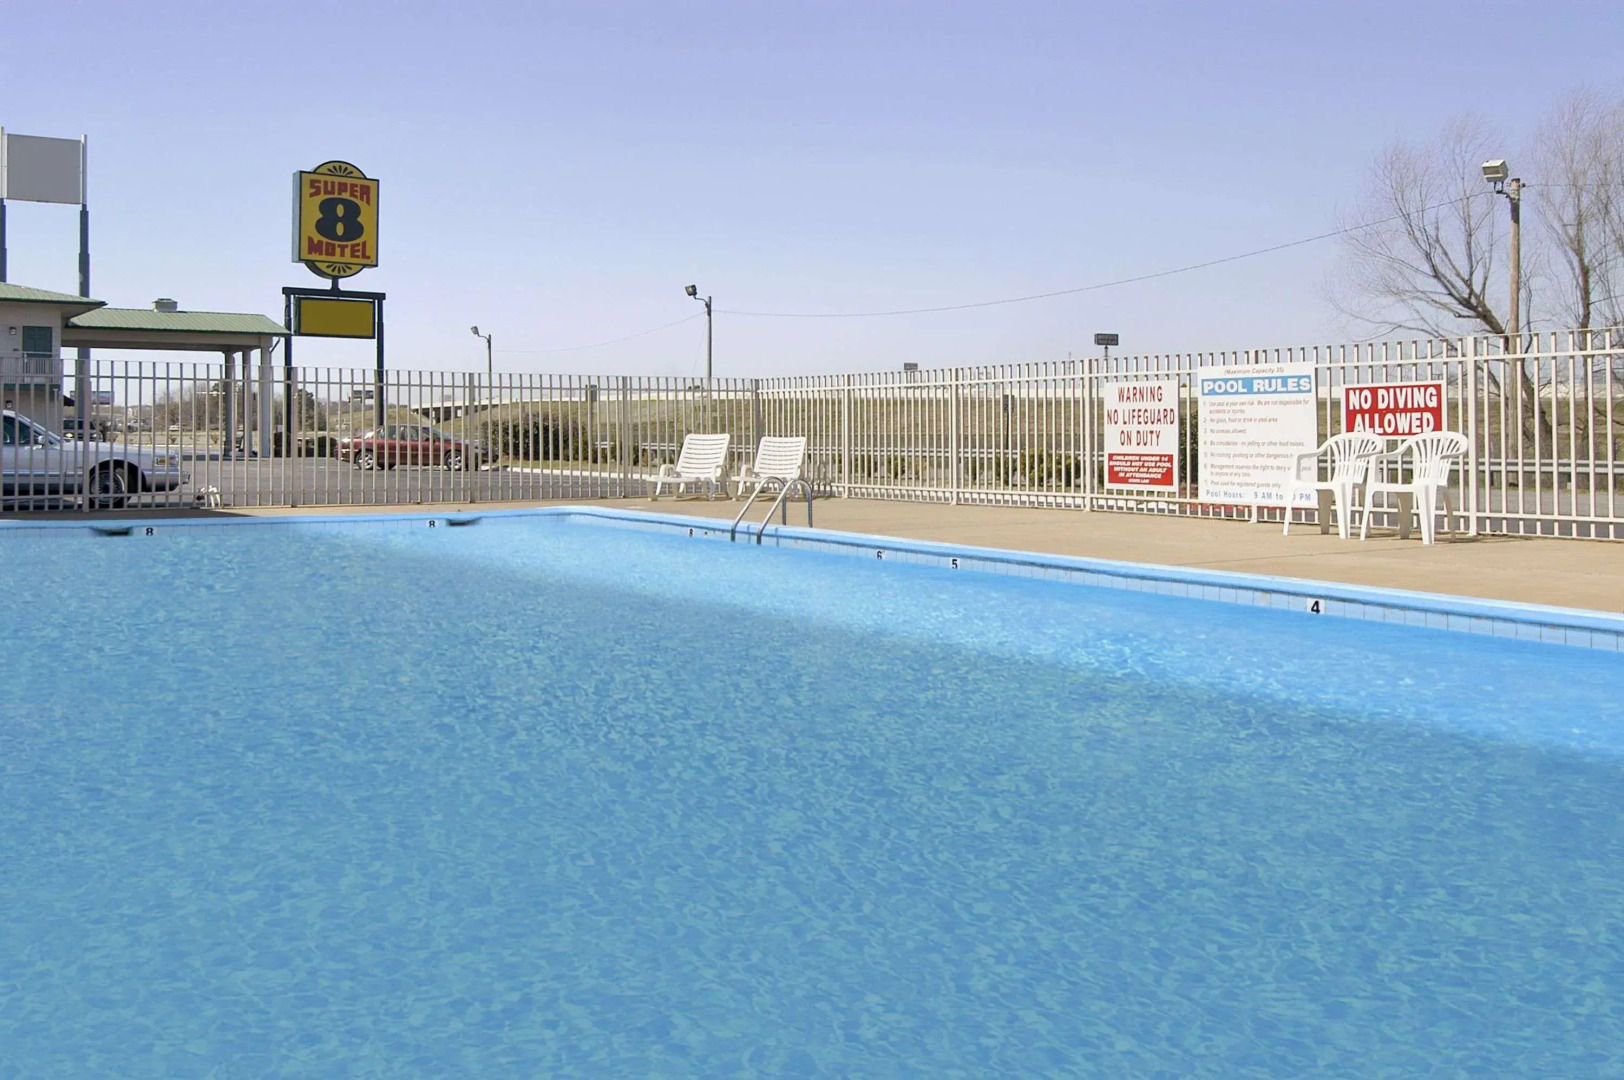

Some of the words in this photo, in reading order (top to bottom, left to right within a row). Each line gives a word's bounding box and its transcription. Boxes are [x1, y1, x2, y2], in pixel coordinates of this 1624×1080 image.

[309, 179, 371, 206] SUPER
[315, 197, 364, 242] 8
[308, 235, 371, 260] MOTEL
[1251, 367, 1275, 375] Capacity
[1118, 386, 1162, 402] WARNING
[1203, 380, 1248, 394] POOL
[1253, 378, 1311, 393] RULES
[1349, 388, 1372, 410] NO
[1377, 386, 1438, 410] DIVING
[1107, 409, 1119, 425] NO
[1122, 408, 1175, 425] LIFEGUARD
[1353, 411, 1435, 434] ALLOWED
[1120, 430, 1132, 446] ON
[1136, 430, 1160, 446] DUTY
[1206, 489, 1221, 497] Pool
[1223, 490, 1245, 499] Hours:
[1253, 491, 1258, 499] 9
[1261, 491, 1273, 500] AM
[1275, 492, 1284, 500] to
[1299, 493, 1311, 501] PM
[146, 527, 154, 536] 8
[1311, 600, 1321, 614] 4
